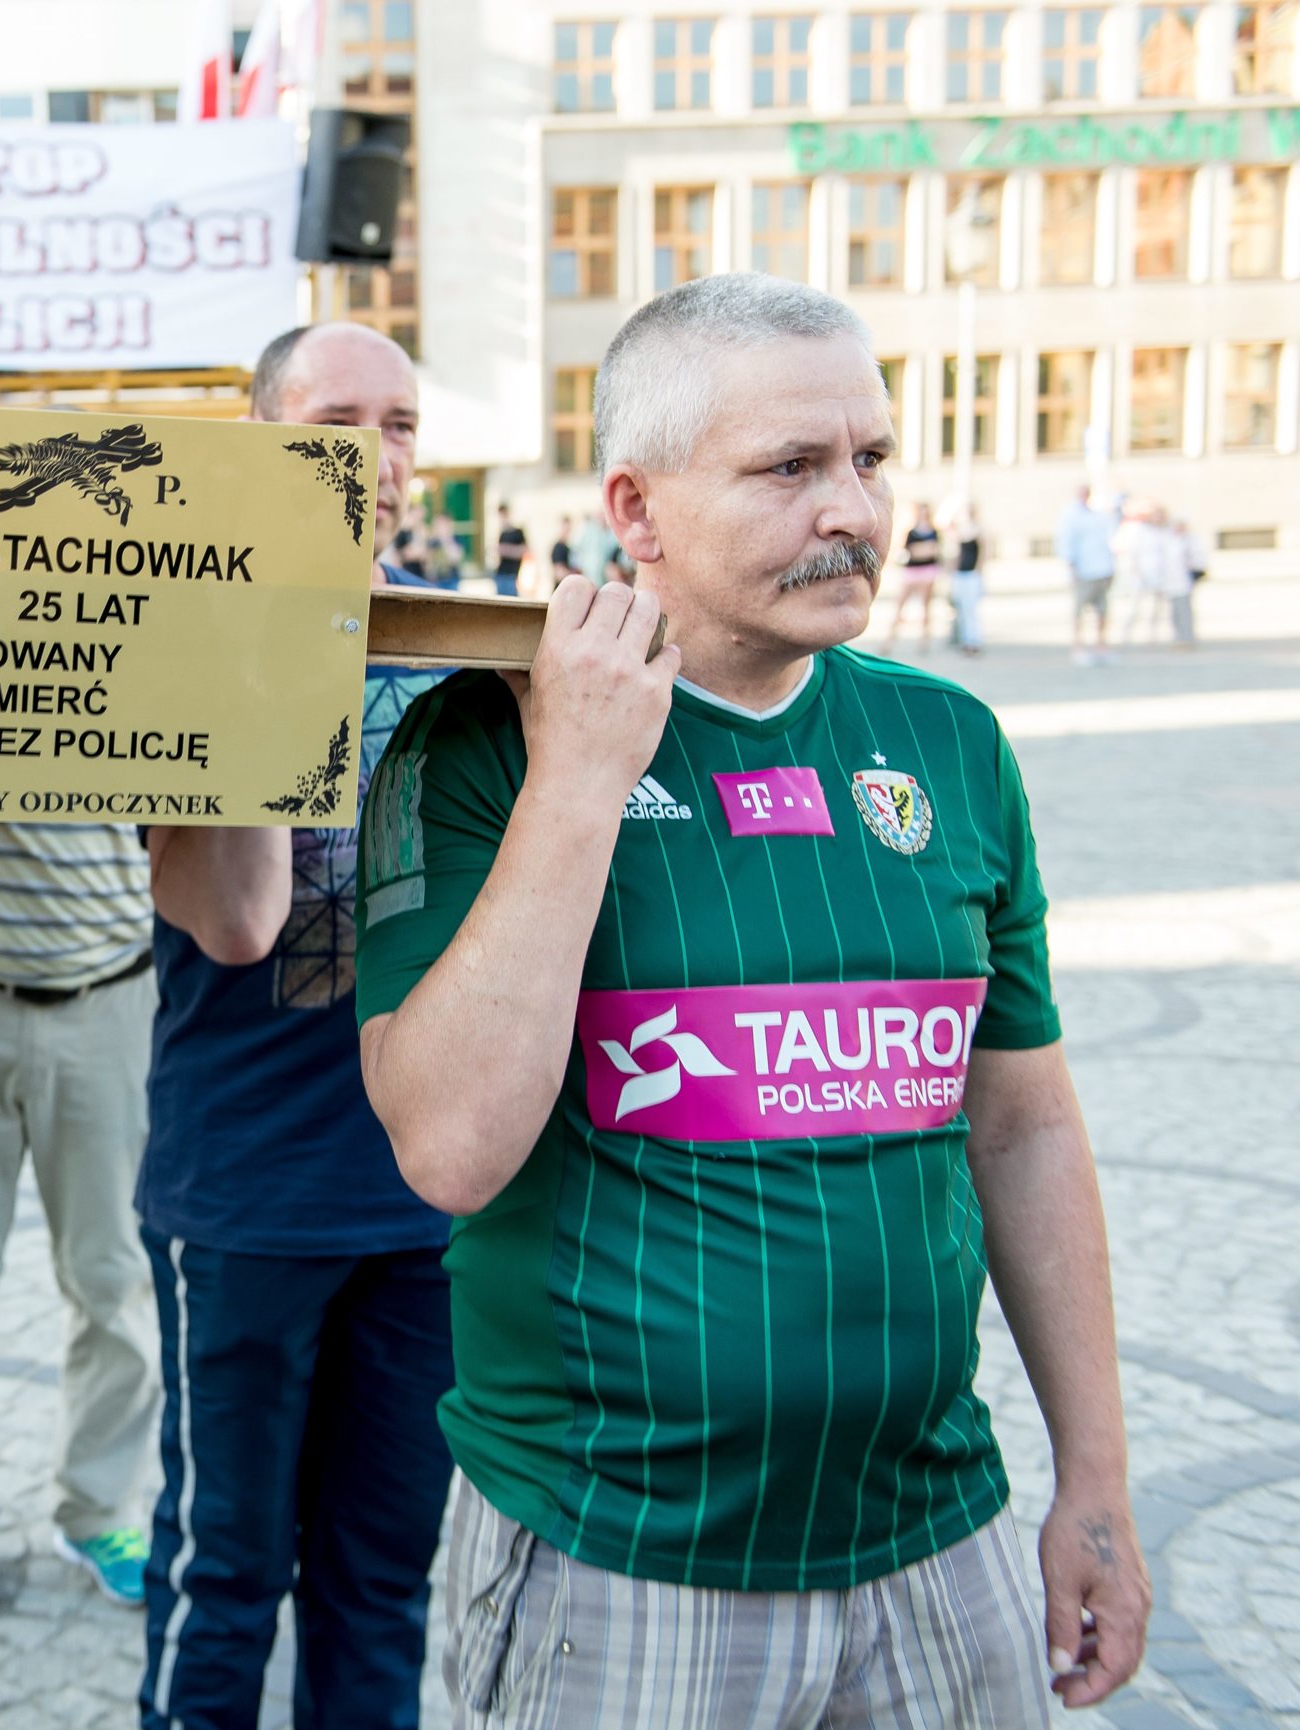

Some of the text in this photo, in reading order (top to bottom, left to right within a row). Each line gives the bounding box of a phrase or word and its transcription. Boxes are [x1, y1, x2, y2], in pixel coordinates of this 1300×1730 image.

[786, 120, 938, 172] Bank
[960, 108, 1241, 170] Zachodni
[156, 475, 187, 506] P.
[17, 590, 63, 623] 25
[76, 592, 150, 626] LAT
[53, 729, 210, 769] POLICJĘ
[19, 792, 224, 816] ODPOCZYNEK
[621, 802, 693, 820] adidas
[757, 1079, 888, 1116] POLSKA
